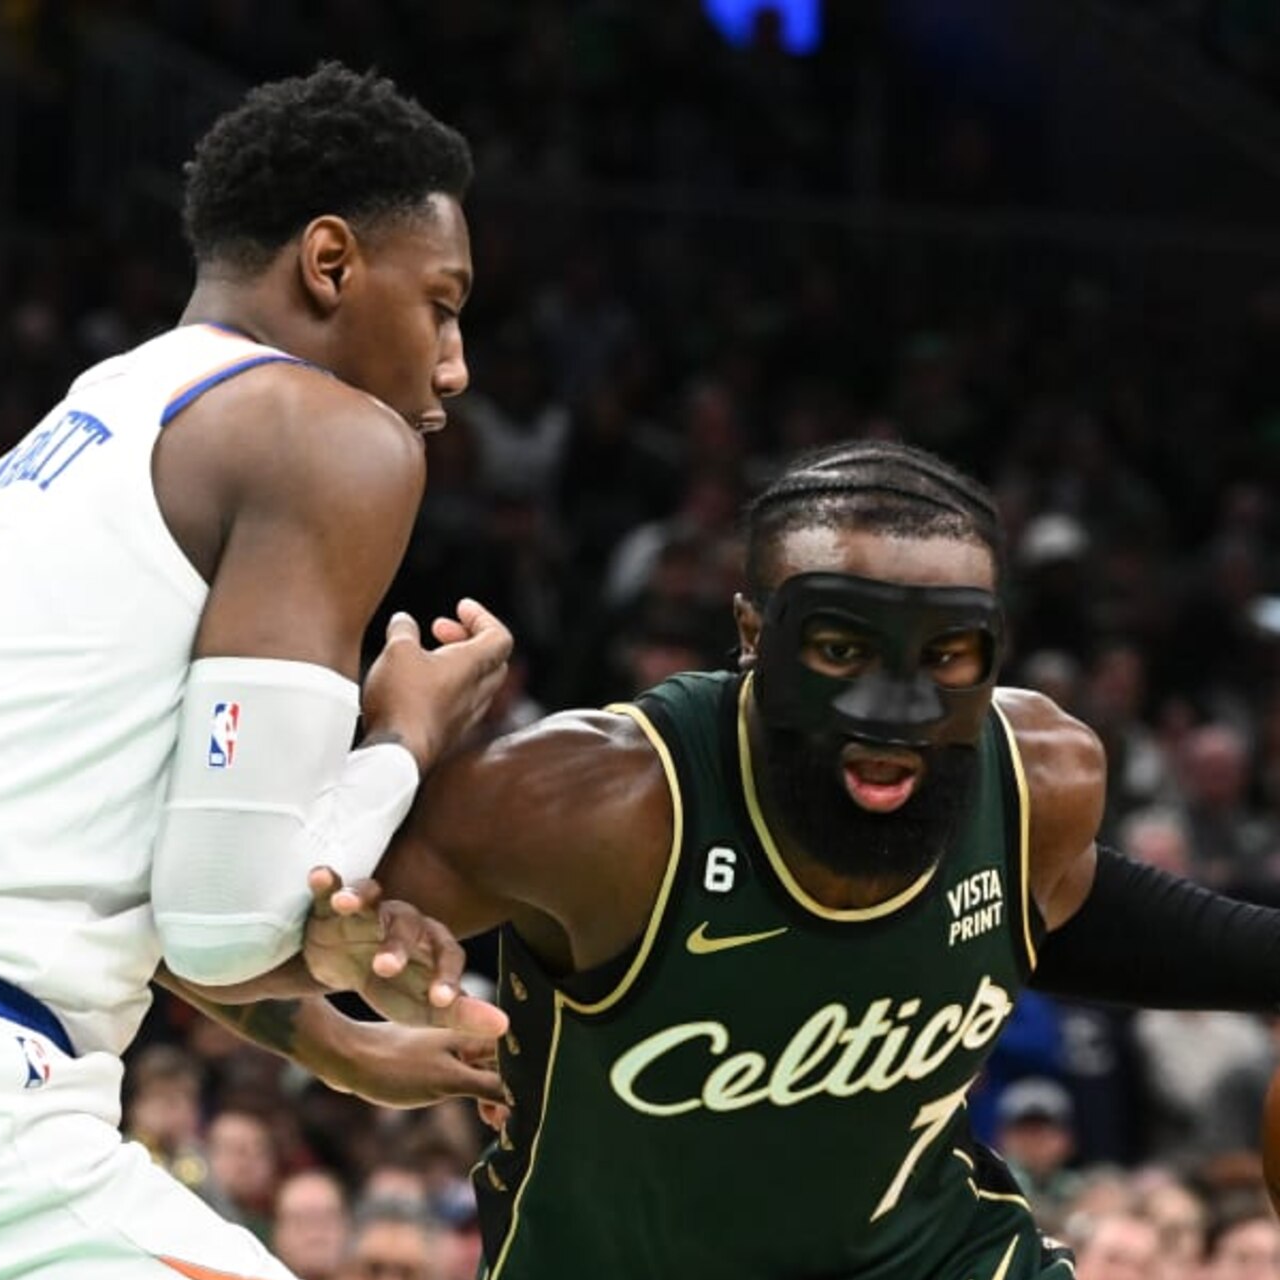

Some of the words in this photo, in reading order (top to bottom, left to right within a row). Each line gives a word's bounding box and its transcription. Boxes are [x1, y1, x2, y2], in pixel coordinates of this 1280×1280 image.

[703, 847, 735, 893] 6
[946, 869, 1003, 918] VISTA
[948, 901, 1004, 947] PRINT
[609, 975, 1013, 1117] Celtics
[870, 1075, 977, 1223] 7
